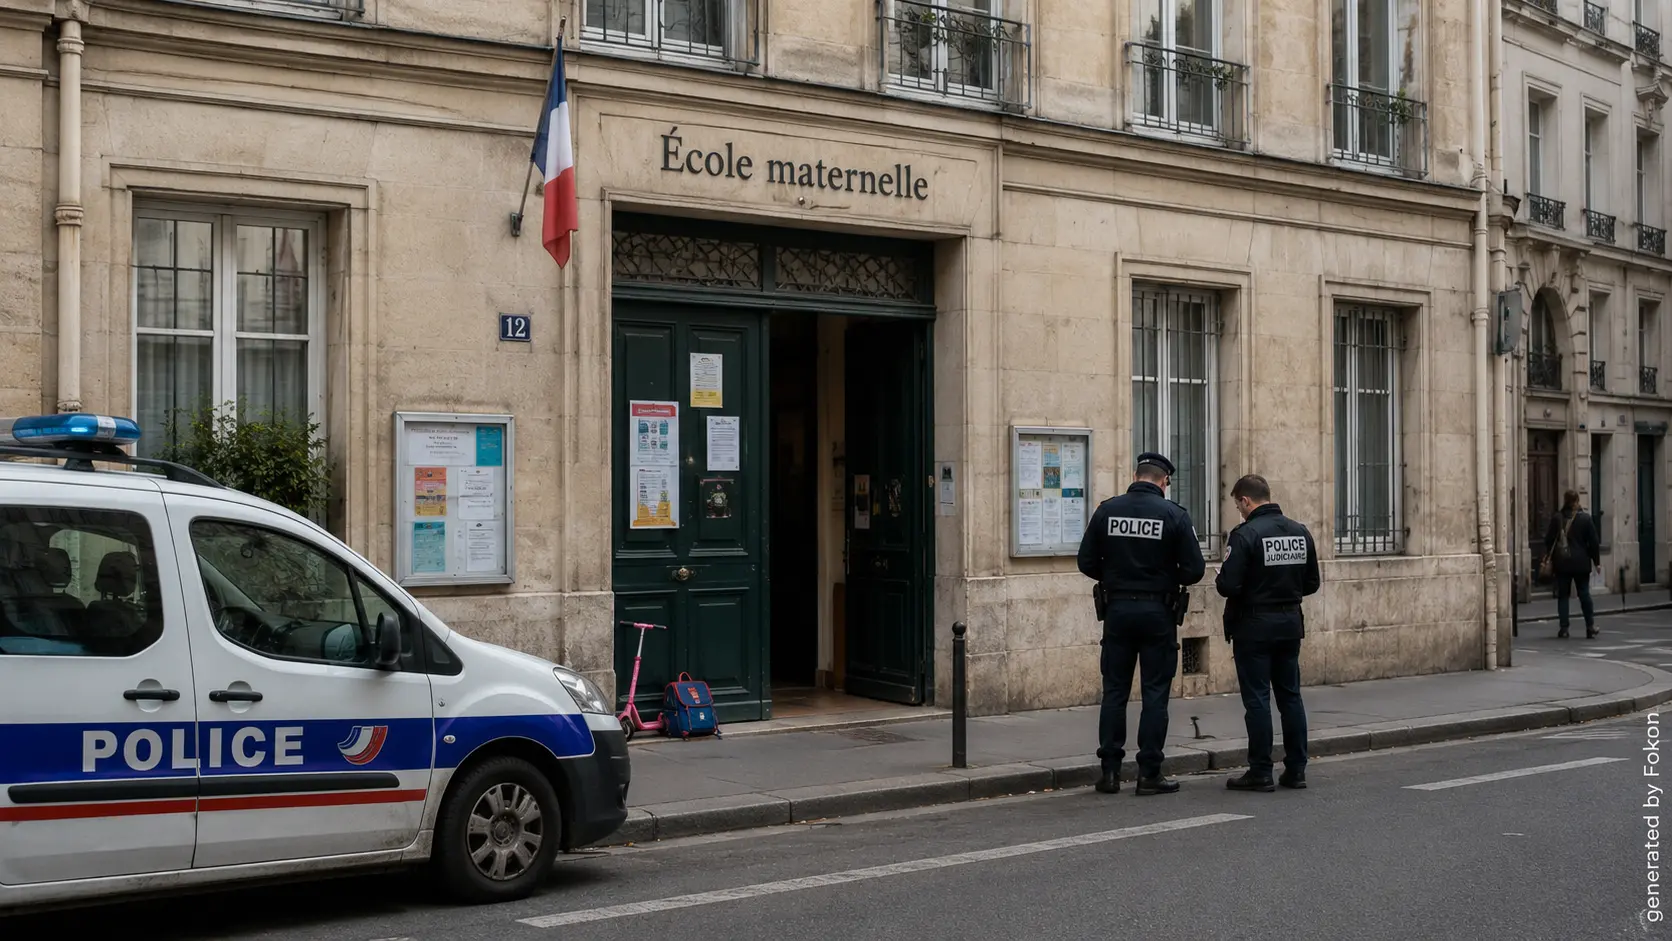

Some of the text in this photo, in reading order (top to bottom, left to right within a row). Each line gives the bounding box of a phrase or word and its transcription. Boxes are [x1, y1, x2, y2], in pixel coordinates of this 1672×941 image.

[660, 126, 929, 201] École maternelle
[506, 316, 526, 337] 12
[1110, 519, 1161, 537] POLICE
[1265, 538, 1305, 552] POLICE
[82, 726, 304, 773] POLICE
